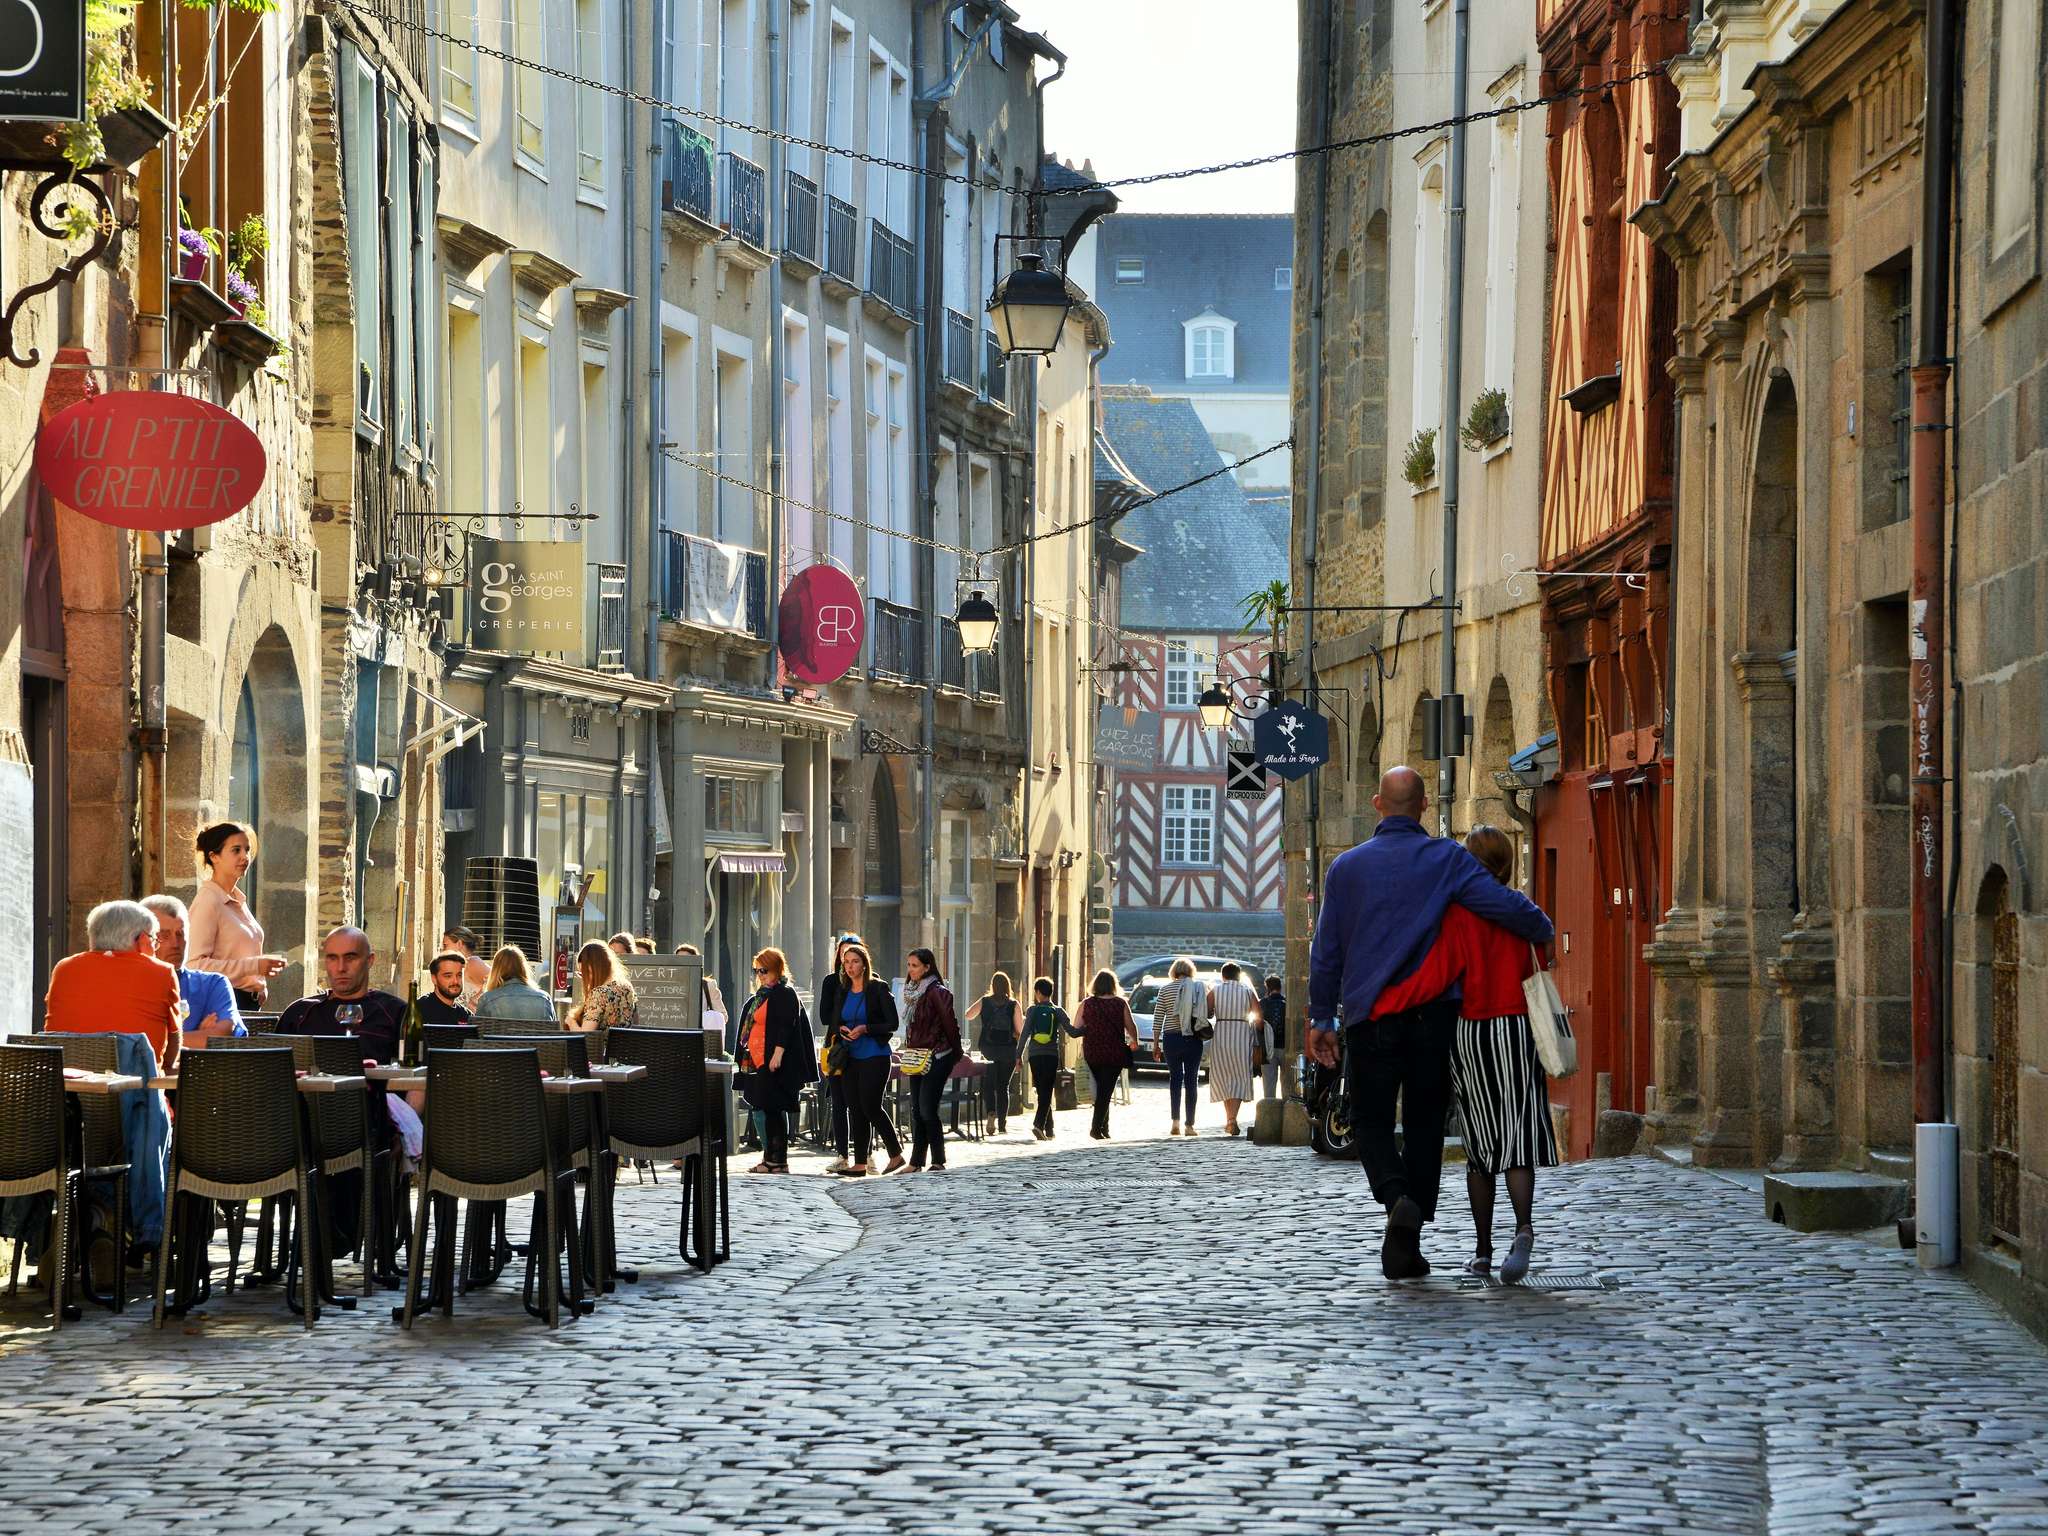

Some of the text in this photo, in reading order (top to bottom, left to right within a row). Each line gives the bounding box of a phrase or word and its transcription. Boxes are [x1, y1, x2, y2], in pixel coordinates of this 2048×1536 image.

[54, 415, 234, 462] AU P'TIT
[74, 466, 241, 509] GRENIER
[511, 570, 564, 584] LA SAINT
[480, 619, 573, 630] CRÊPERIE
[1101, 728, 1153, 745] CHEZ LES
[1264, 754, 1320, 765] Made in Frogs
